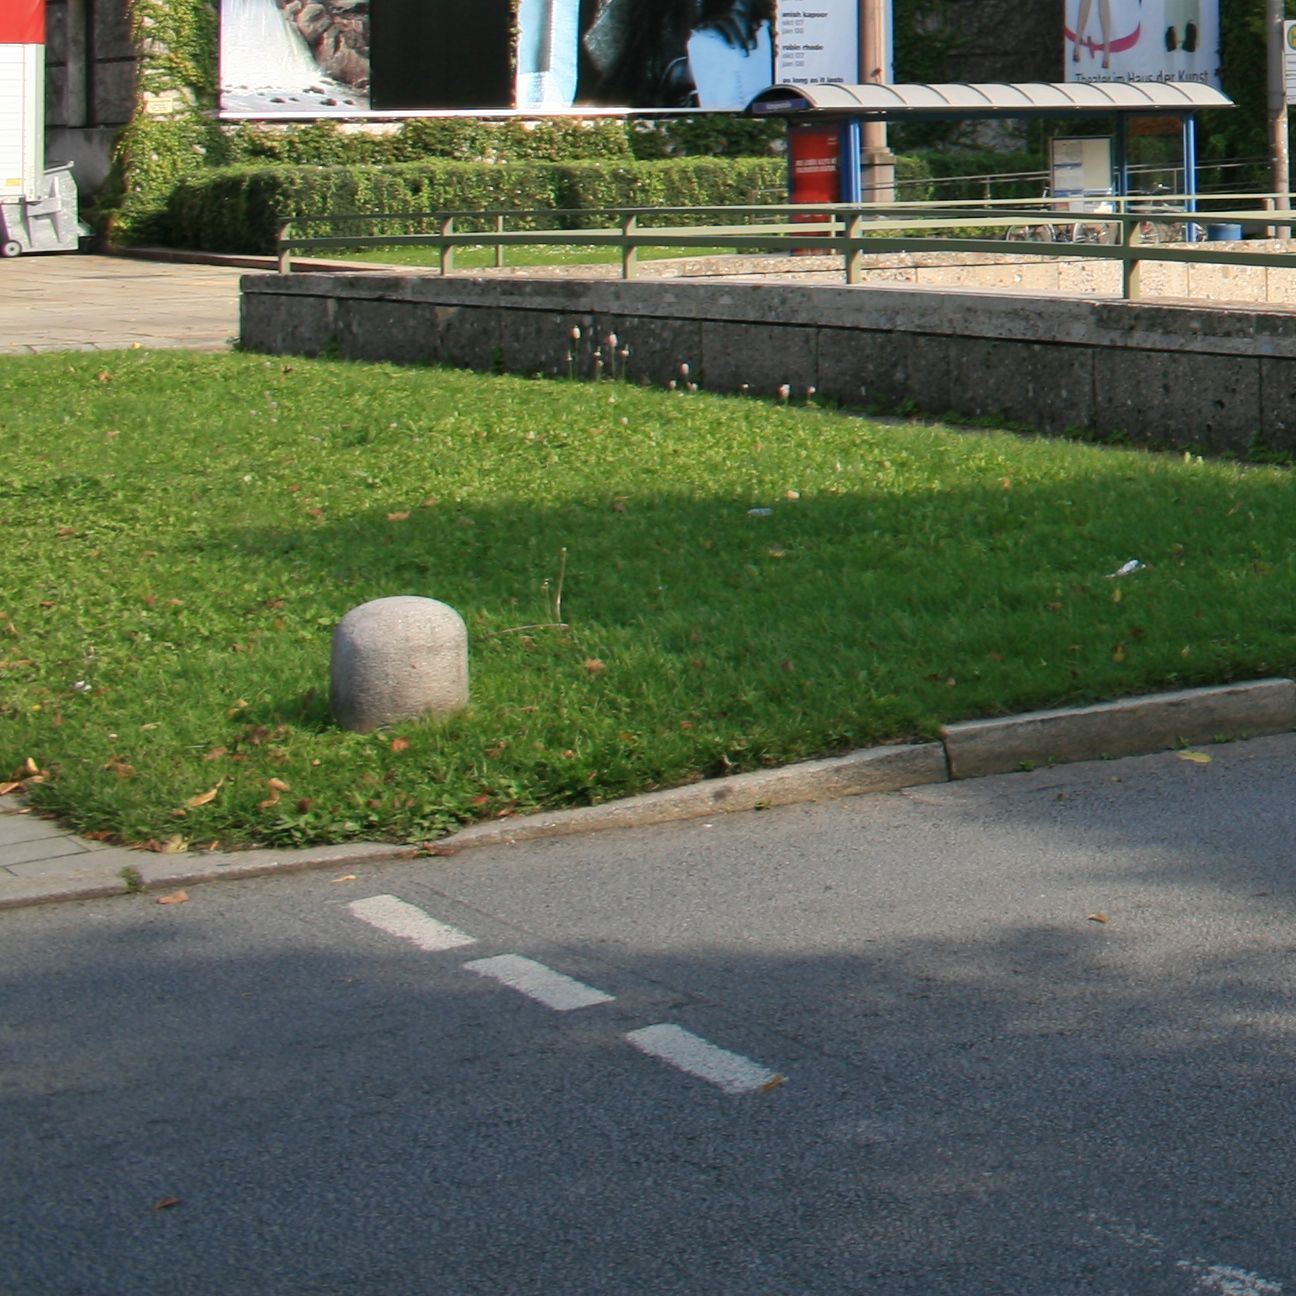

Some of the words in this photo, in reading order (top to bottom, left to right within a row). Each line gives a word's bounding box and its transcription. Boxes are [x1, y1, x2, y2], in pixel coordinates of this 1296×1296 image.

[1127, 71, 1153, 83] Haus
[1156, 70, 1175, 83] der
[1178, 70, 1208, 82] Kunst
